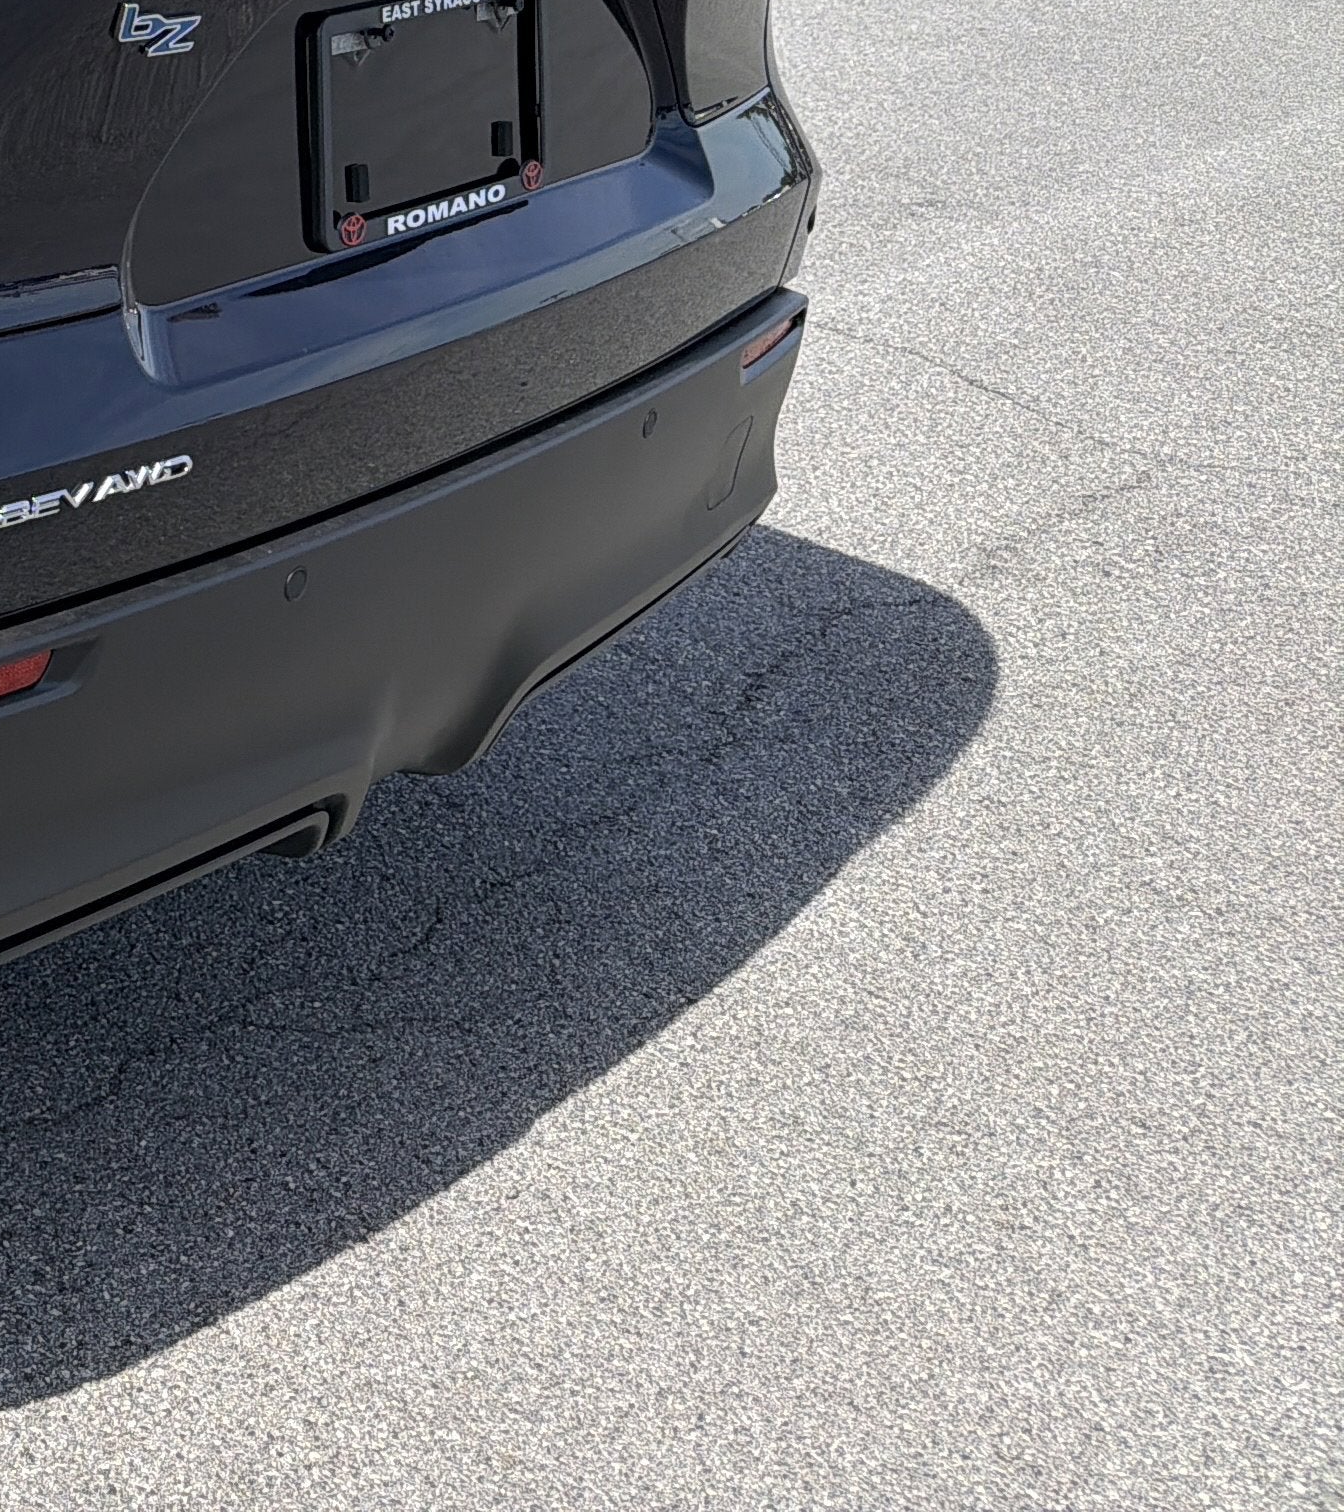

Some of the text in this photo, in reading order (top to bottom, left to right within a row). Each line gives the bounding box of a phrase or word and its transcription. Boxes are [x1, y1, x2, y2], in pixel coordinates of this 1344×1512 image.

[382, 0, 421, 23] EAST
[387, 184, 506, 236] ROMANO
[92, 454, 194, 502] AWD
